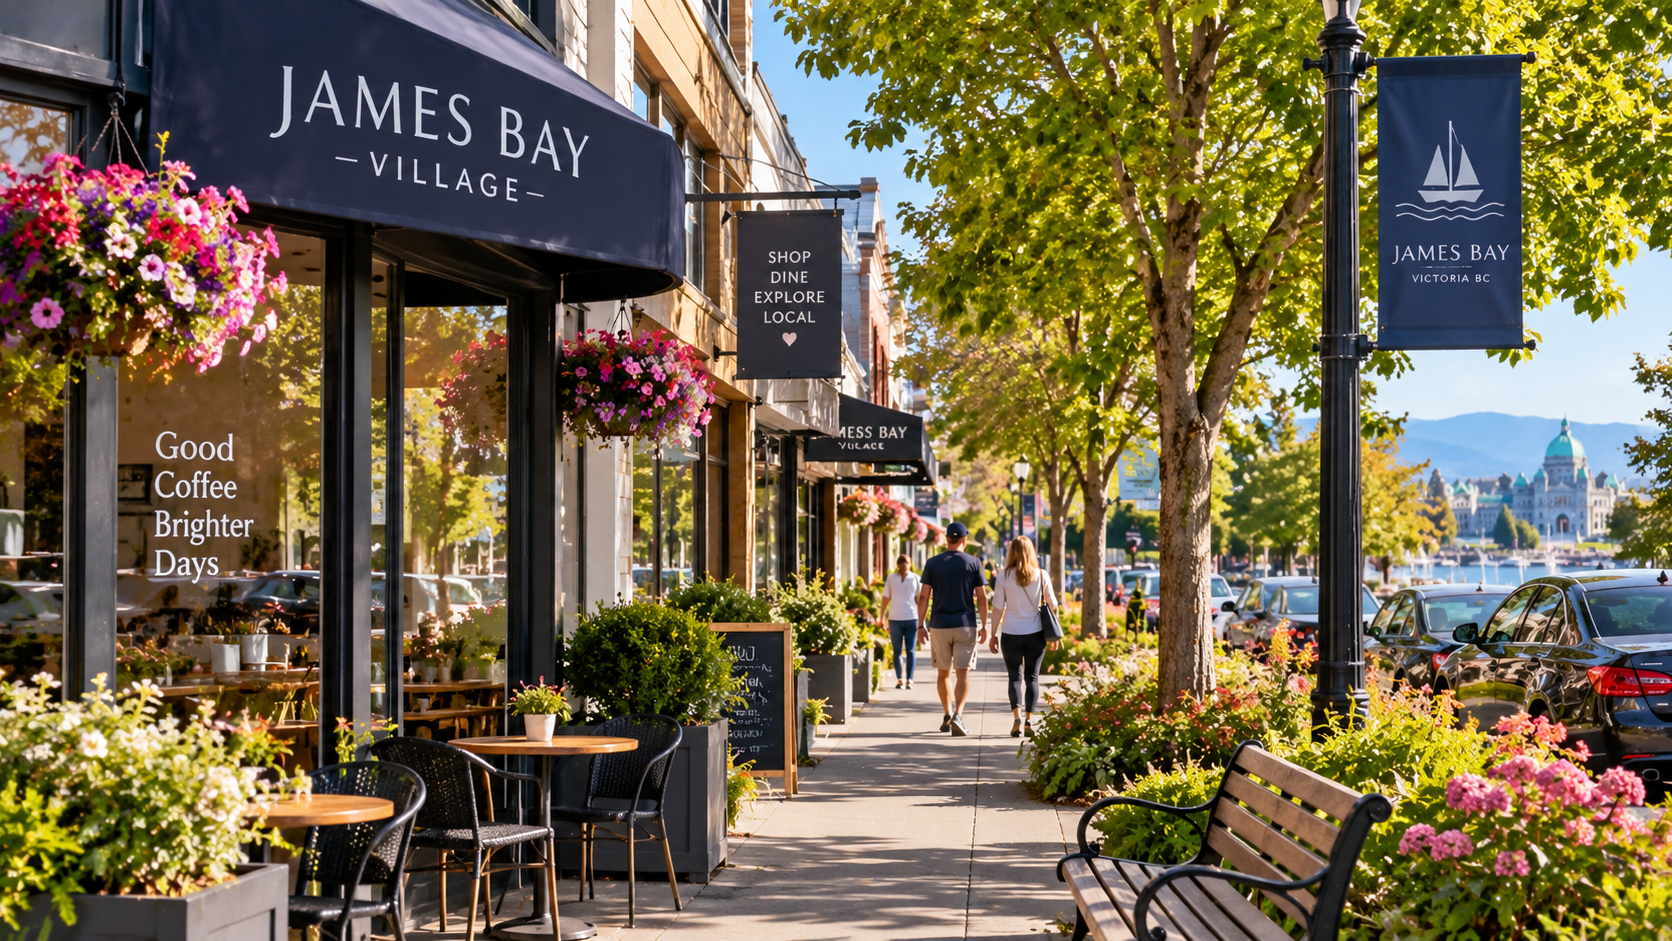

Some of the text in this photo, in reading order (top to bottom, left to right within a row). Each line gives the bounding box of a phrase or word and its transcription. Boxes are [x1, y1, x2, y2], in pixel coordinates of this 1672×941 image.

[269, 65, 590, 179] JAMES BAY
[369, 151, 519, 203] VILLAGE
[768, 250, 812, 264] SHOP
[1391, 243, 1510, 265] JAMES BAY
[770, 270, 809, 284] DINE
[1411, 274, 1491, 283] VICTORIA BC
[754, 290, 826, 304] EXPLORE
[763, 310, 816, 324] LOCAL
[879, 426, 908, 439] BAY
[155, 430, 235, 462] Good
[154, 470, 238, 499] Coffee
[154, 508, 255, 546] Brighter
[154, 549, 220, 584] Days
